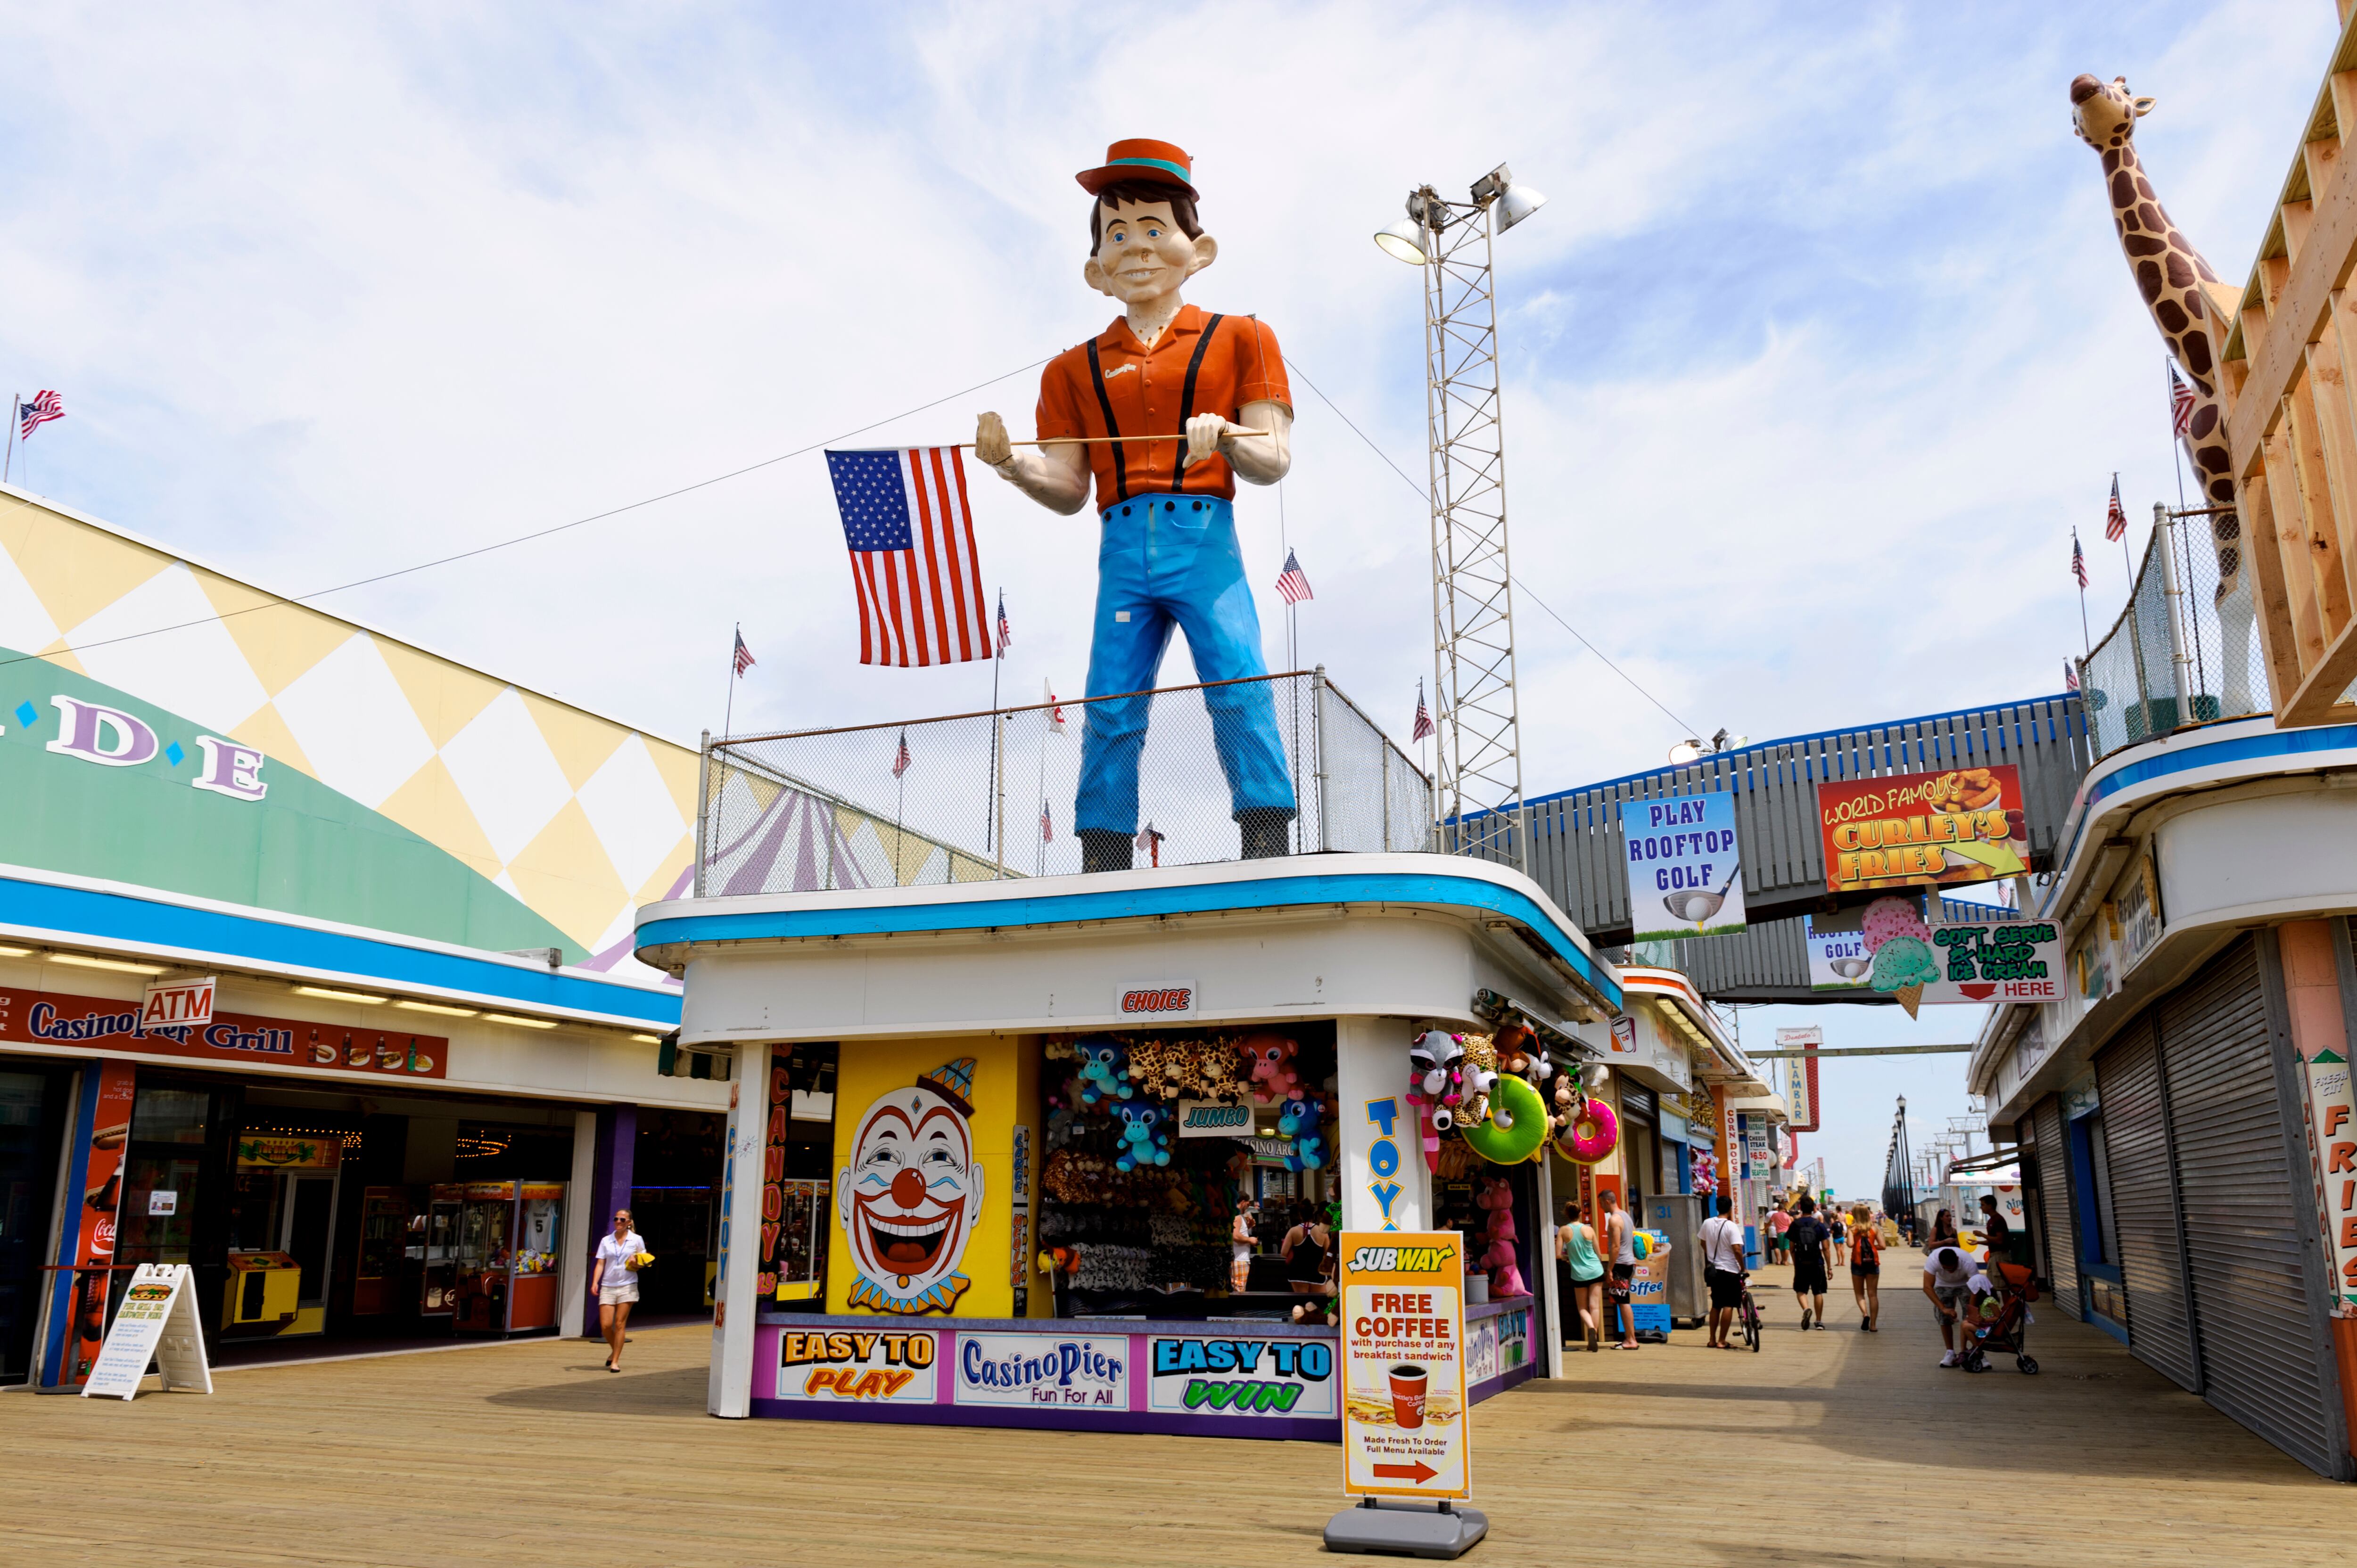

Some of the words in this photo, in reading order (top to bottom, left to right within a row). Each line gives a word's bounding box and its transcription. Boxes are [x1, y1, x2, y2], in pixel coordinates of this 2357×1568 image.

[1825, 794, 1885, 826] WORLD
[1887, 772, 1959, 810] FAMOUS
[1649, 800, 1705, 828] PLAY
[1833, 809, 2011, 851] CURLEY'S
[1629, 829, 1733, 861] ROOFTOP
[1656, 864, 1713, 890] GOLF
[1838, 844, 1946, 882] FRIES
[1933, 927, 1989, 946] SOFT
[1994, 923, 2057, 944] SERVE
[1826, 942, 1861, 958] GOLF
[1948, 944, 1975, 965] &
[1976, 943, 2035, 963] HARD
[1947, 962, 1977, 981] ICE
[1981, 961, 2048, 980] CREAM
[1122, 988, 1191, 1012] CHOICE
[2005, 982, 2054, 996] HERE
[144, 988, 212, 1021] ATM
[204, 1024, 294, 1054] Grill
[2314, 1070, 2348, 1087] FRESH
[2323, 1084, 2343, 1096] CUT
[1184, 1105, 1250, 1128] JUMBO
[1727, 1110, 1736, 1139] CORN
[1014, 1133, 1024, 1192] LARGE
[1276, 1143, 1294, 1155] ARC
[1730, 1143, 1738, 1174] DOGS
[1750, 1152, 1767, 1160] $6.50
[761, 1067, 790, 1263] CANDY
[1365, 1096, 1405, 1231] TOY
[720, 1124, 735, 1284] CANDY
[2303, 1102, 2335, 1290] ZEPPOLE
[1656, 1206, 1672, 1218] 31
[536, 1220, 543, 1233] 5
[1012, 1214, 1023, 1286] MEDIUM
[1346, 1243, 1456, 1274] SUBWAY
[1630, 1281, 1663, 1295] offee
[1372, 1293, 1432, 1313] FREE
[1356, 1317, 1450, 1338] COFFEE
[1498, 1312, 1516, 1346] EASY
[1517, 1309, 1526, 1338] TO
[781, 1332, 880, 1367] EASY
[881, 1333, 935, 1369] TO
[1354, 1350, 1401, 1359] breakfast
[1405, 1352, 1452, 1361] sandwich
[1375, 1339, 1421, 1348] purchase
[1425, 1339, 1434, 1347] of
[1437, 1341, 1455, 1350] any
[962, 1338, 1124, 1387] CasinoPier
[1153, 1339, 1267, 1377] EASY
[1268, 1342, 1332, 1381] TO
[804, 1368, 915, 1400] PLAY
[1032, 1387, 1057, 1402] Fun
[1065, 1388, 1087, 1403] For
[1094, 1390, 1113, 1404] All
[1181, 1379, 1304, 1414] WIN
